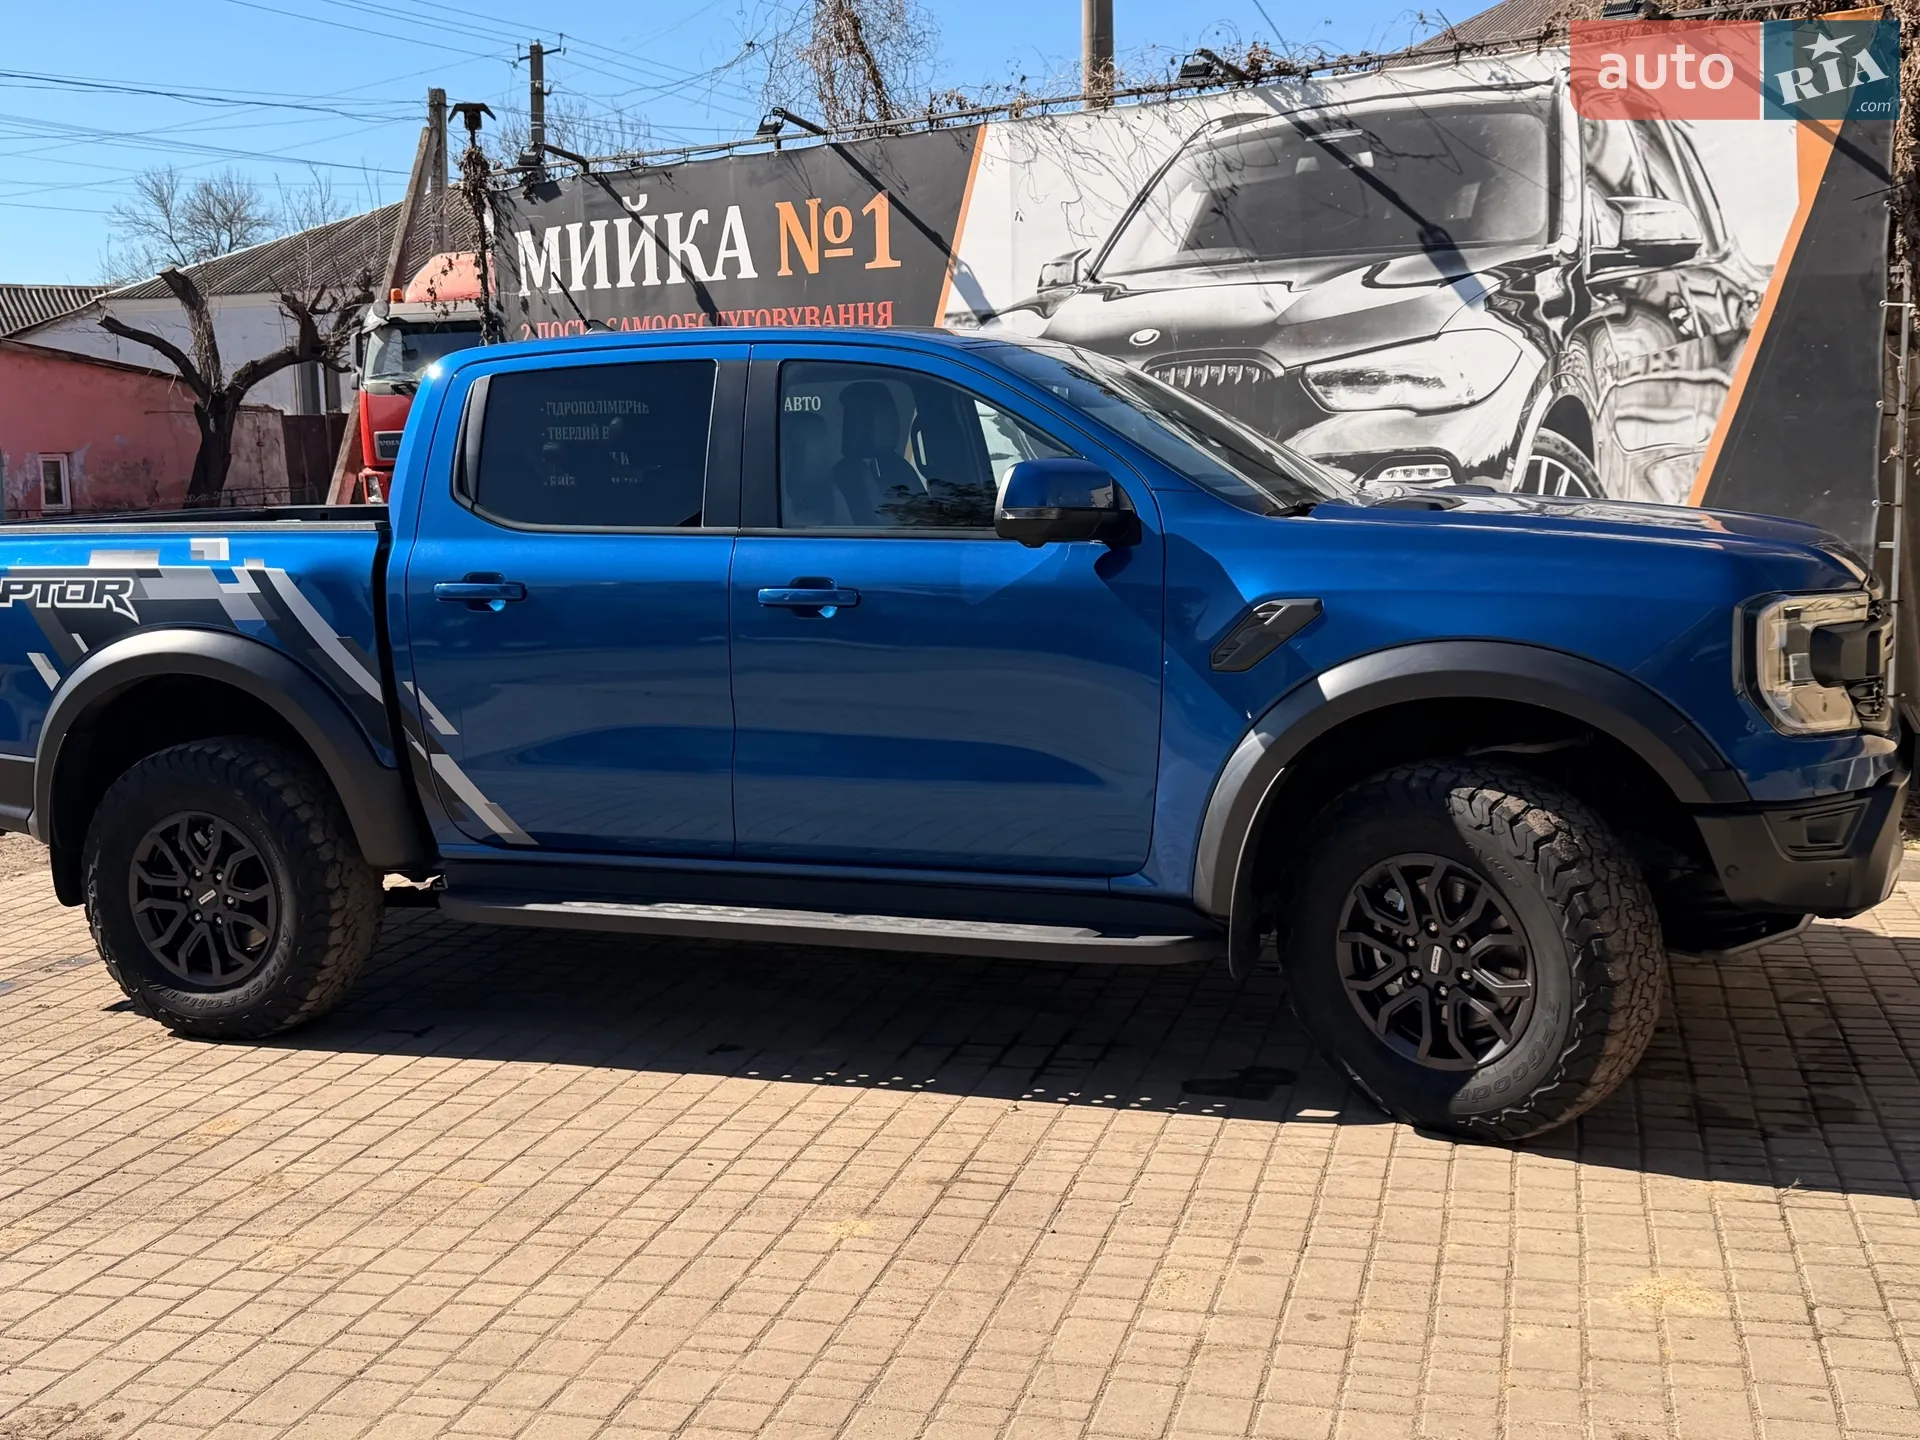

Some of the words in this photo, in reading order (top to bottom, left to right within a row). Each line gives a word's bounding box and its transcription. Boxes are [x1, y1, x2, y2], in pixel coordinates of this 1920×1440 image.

[514, 194, 759, 297] МИЙКА
[536, 319, 587, 339] ПОСТ
[784, 396, 822, 412] АВТО
[547, 424, 600, 441] ТВЕРДИЙ
[0, 577, 141, 625] PTOR
